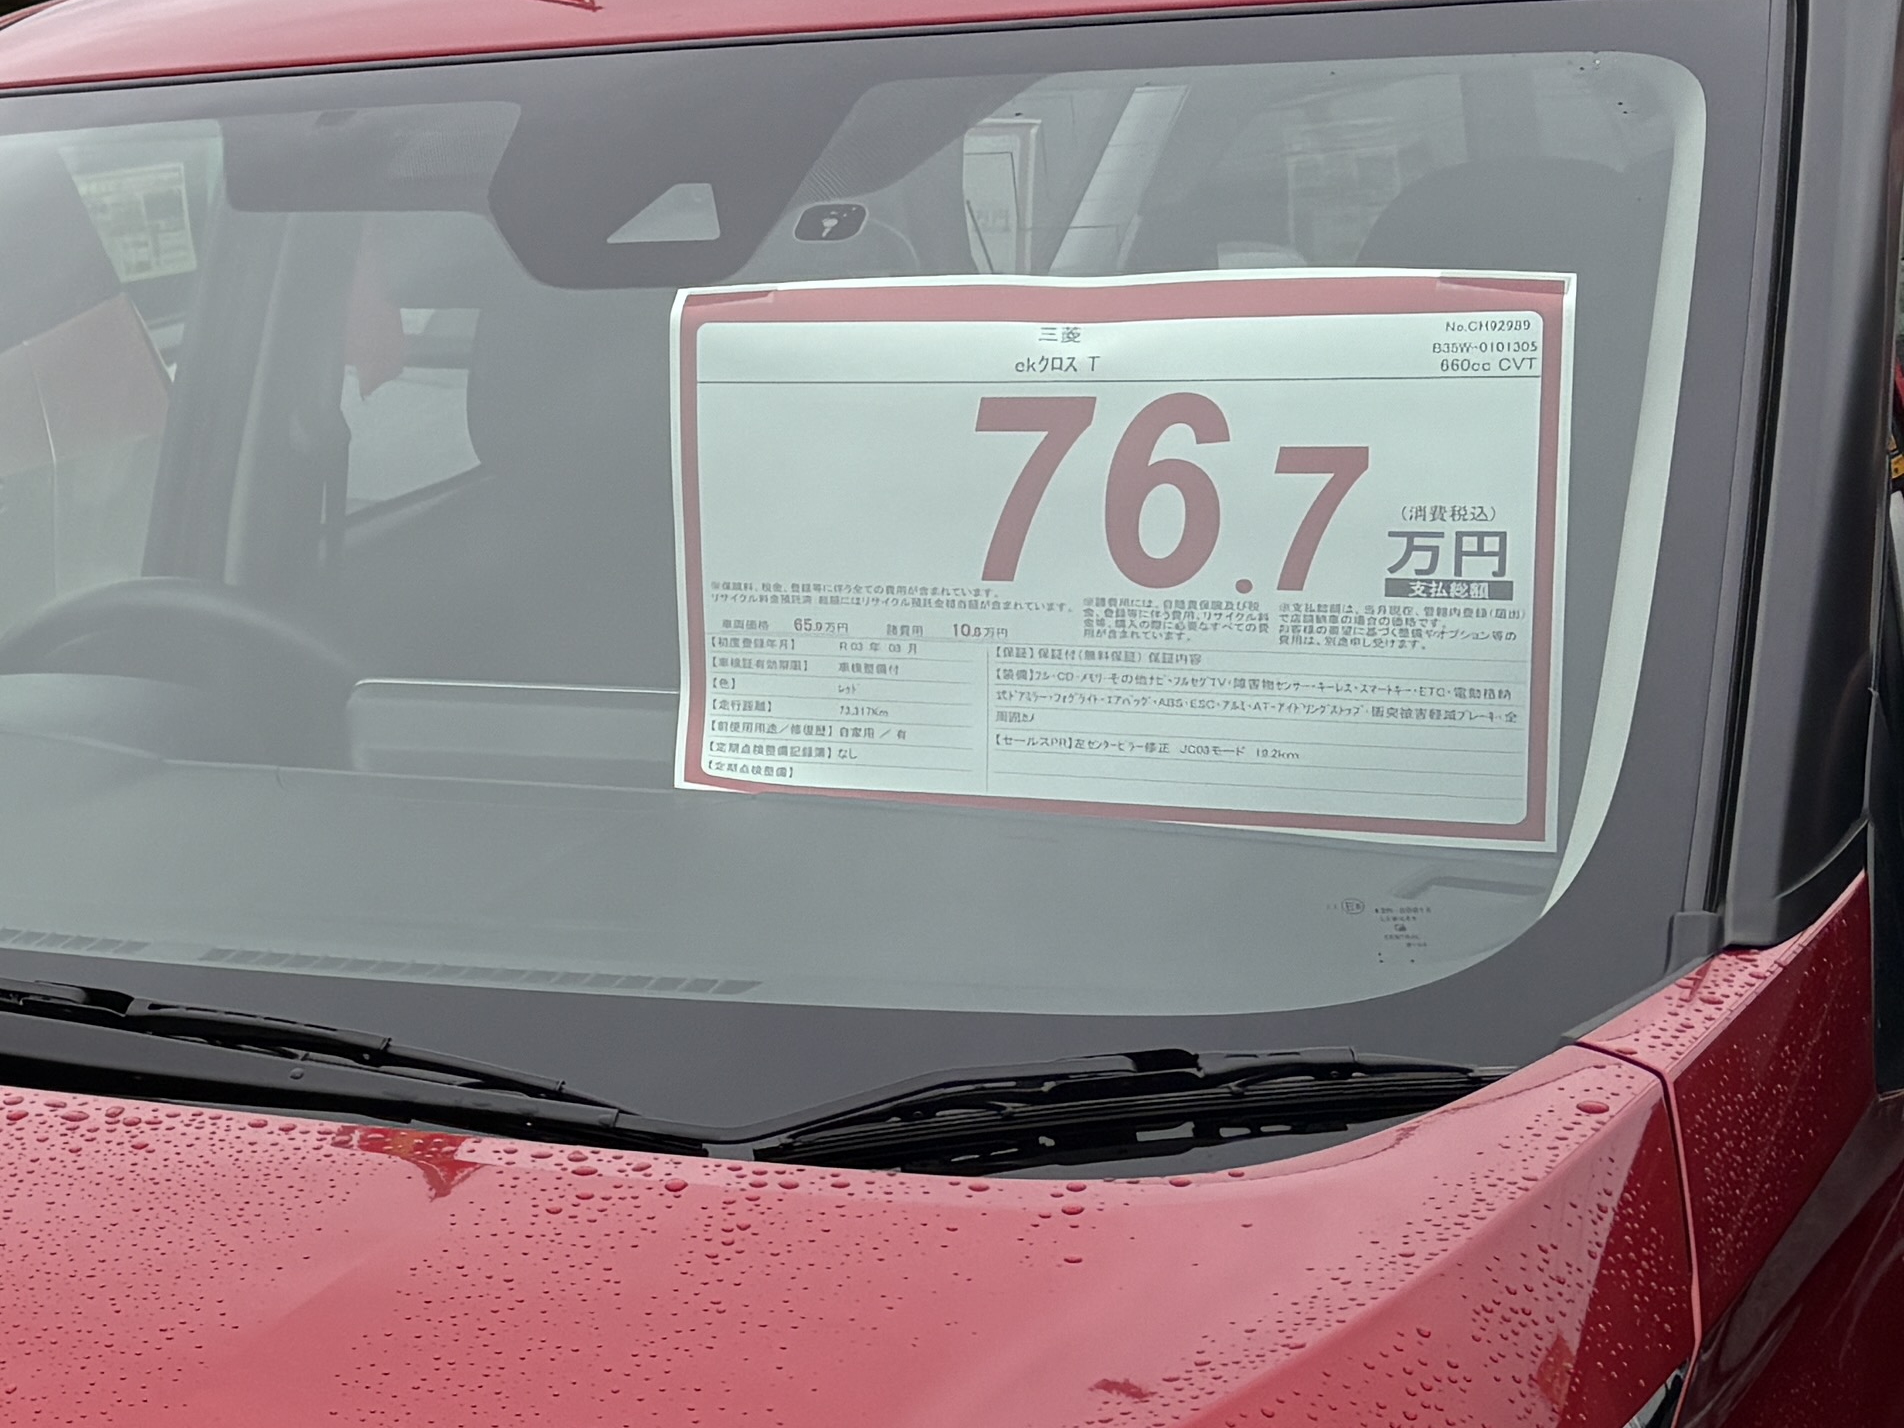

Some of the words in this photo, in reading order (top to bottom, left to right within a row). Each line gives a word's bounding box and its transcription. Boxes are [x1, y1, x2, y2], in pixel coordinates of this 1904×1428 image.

[1037, 326, 1082, 344] 三菱
[1088, 355, 1101, 373] T
[1498, 357, 1538, 371] CVT
[975, 391, 1370, 595] 76.7
[1386, 530, 1508, 578] 万円
[1407, 581, 1489, 599] 支払総額
[712, 677, 736, 690] 【色】
